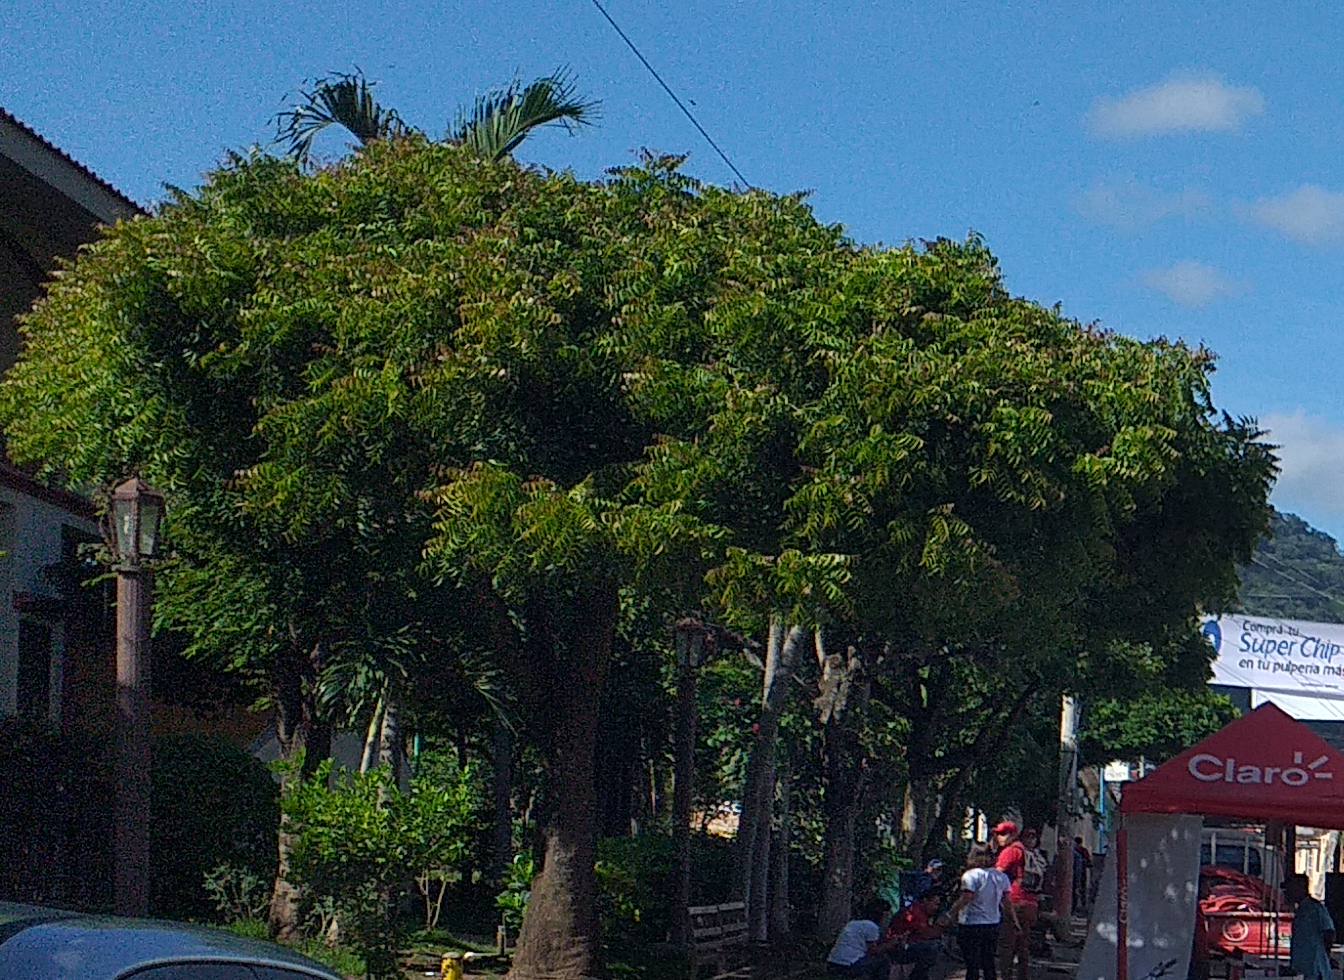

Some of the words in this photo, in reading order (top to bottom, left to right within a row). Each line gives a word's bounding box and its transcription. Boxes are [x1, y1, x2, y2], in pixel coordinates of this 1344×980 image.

[1239, 632, 1298, 660] Super
[1300, 637, 1341, 664] Chip
[1238, 659, 1254, 669] en
[1257, 659, 1270, 670] tu
[1188, 753, 1312, 787] Claro
